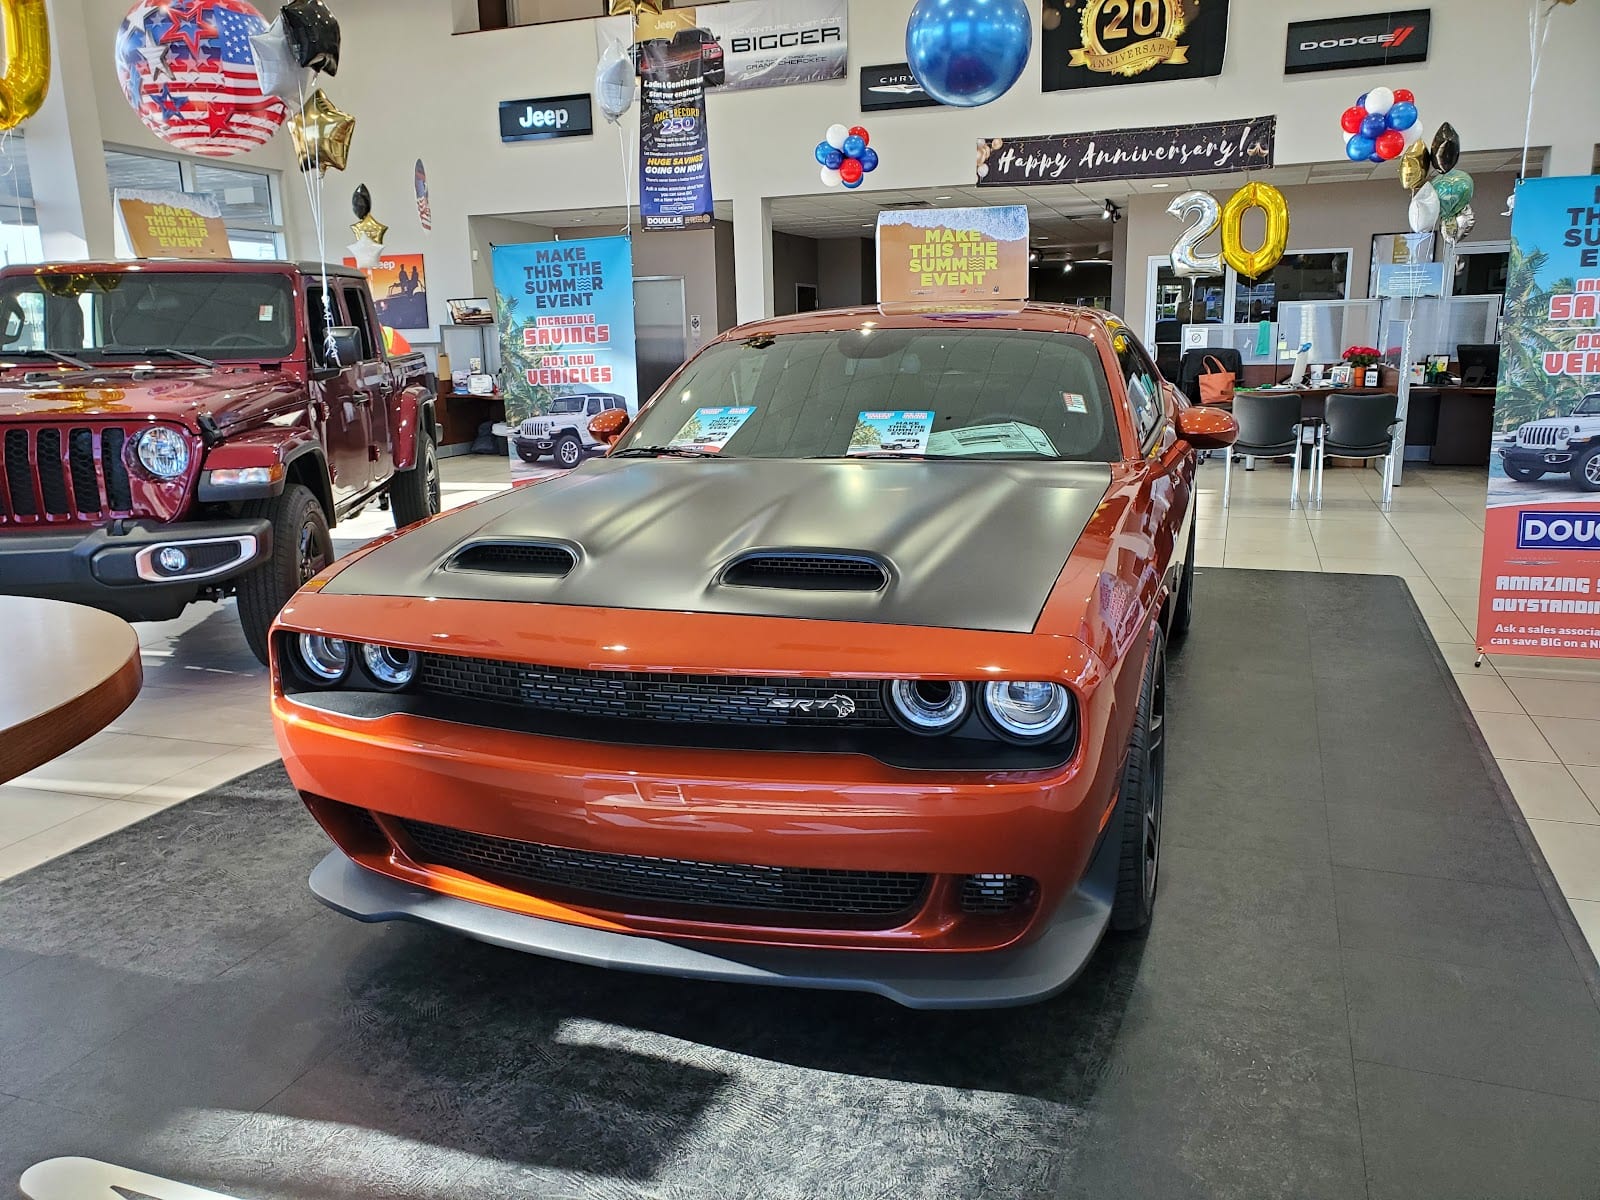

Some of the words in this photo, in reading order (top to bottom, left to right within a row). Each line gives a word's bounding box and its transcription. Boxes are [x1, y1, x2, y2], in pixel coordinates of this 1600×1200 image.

[654, 20, 676, 30] Jeep
[1102, 0, 1160, 39] 20
[731, 26, 840, 53] BIGGER
[1300, 34, 1395, 50] DODGE
[1091, 43, 1174, 68] ANNIVERSARY
[519, 106, 568, 128] Jeep
[654, 109, 669, 122] RACE
[673, 108, 700, 117] RECORD
[660, 117, 695, 134] 250
[998, 148, 1072, 177] Happy
[1078, 126, 1250, 169] Anniversary!
[648, 157, 671, 166] HUGE
[673, 154, 703, 165] SAVINGS
[687, 163, 703, 173] NOW
[152, 206, 192, 217] MAKE
[145, 216, 177, 226] THIS
[179, 217, 206, 227] THE
[926, 229, 981, 243] MAKE
[1166, 181, 1289, 280] 20
[159, 238, 203, 248] EVENT
[909, 244, 954, 258] THIS
[958, 242, 998, 256] THE
[536, 247, 586, 263] MAKE
[524, 265, 563, 279] THIS
[567, 261, 602, 276] THE
[921, 272, 986, 287] EVENT
[536, 293, 593, 308] EVENT
[1550, 295, 1600, 318] SA
[537, 314, 595, 326] INCREDIBLE
[525, 325, 609, 345] SAVINGS
[543, 356, 565, 366] HOT
[569, 355, 594, 365] NEW
[527, 367, 612, 385] VEHICLES
[1524, 520, 1600, 542] DOU
[1496, 576, 1590, 593] AMAZING
[1495, 624, 1516, 633] Ask
[1528, 625, 1556, 634] sales
[1540, 638, 1561, 647] BIG
[1590, 640, 1600, 649] N
[767, 698, 837, 711] SRT
